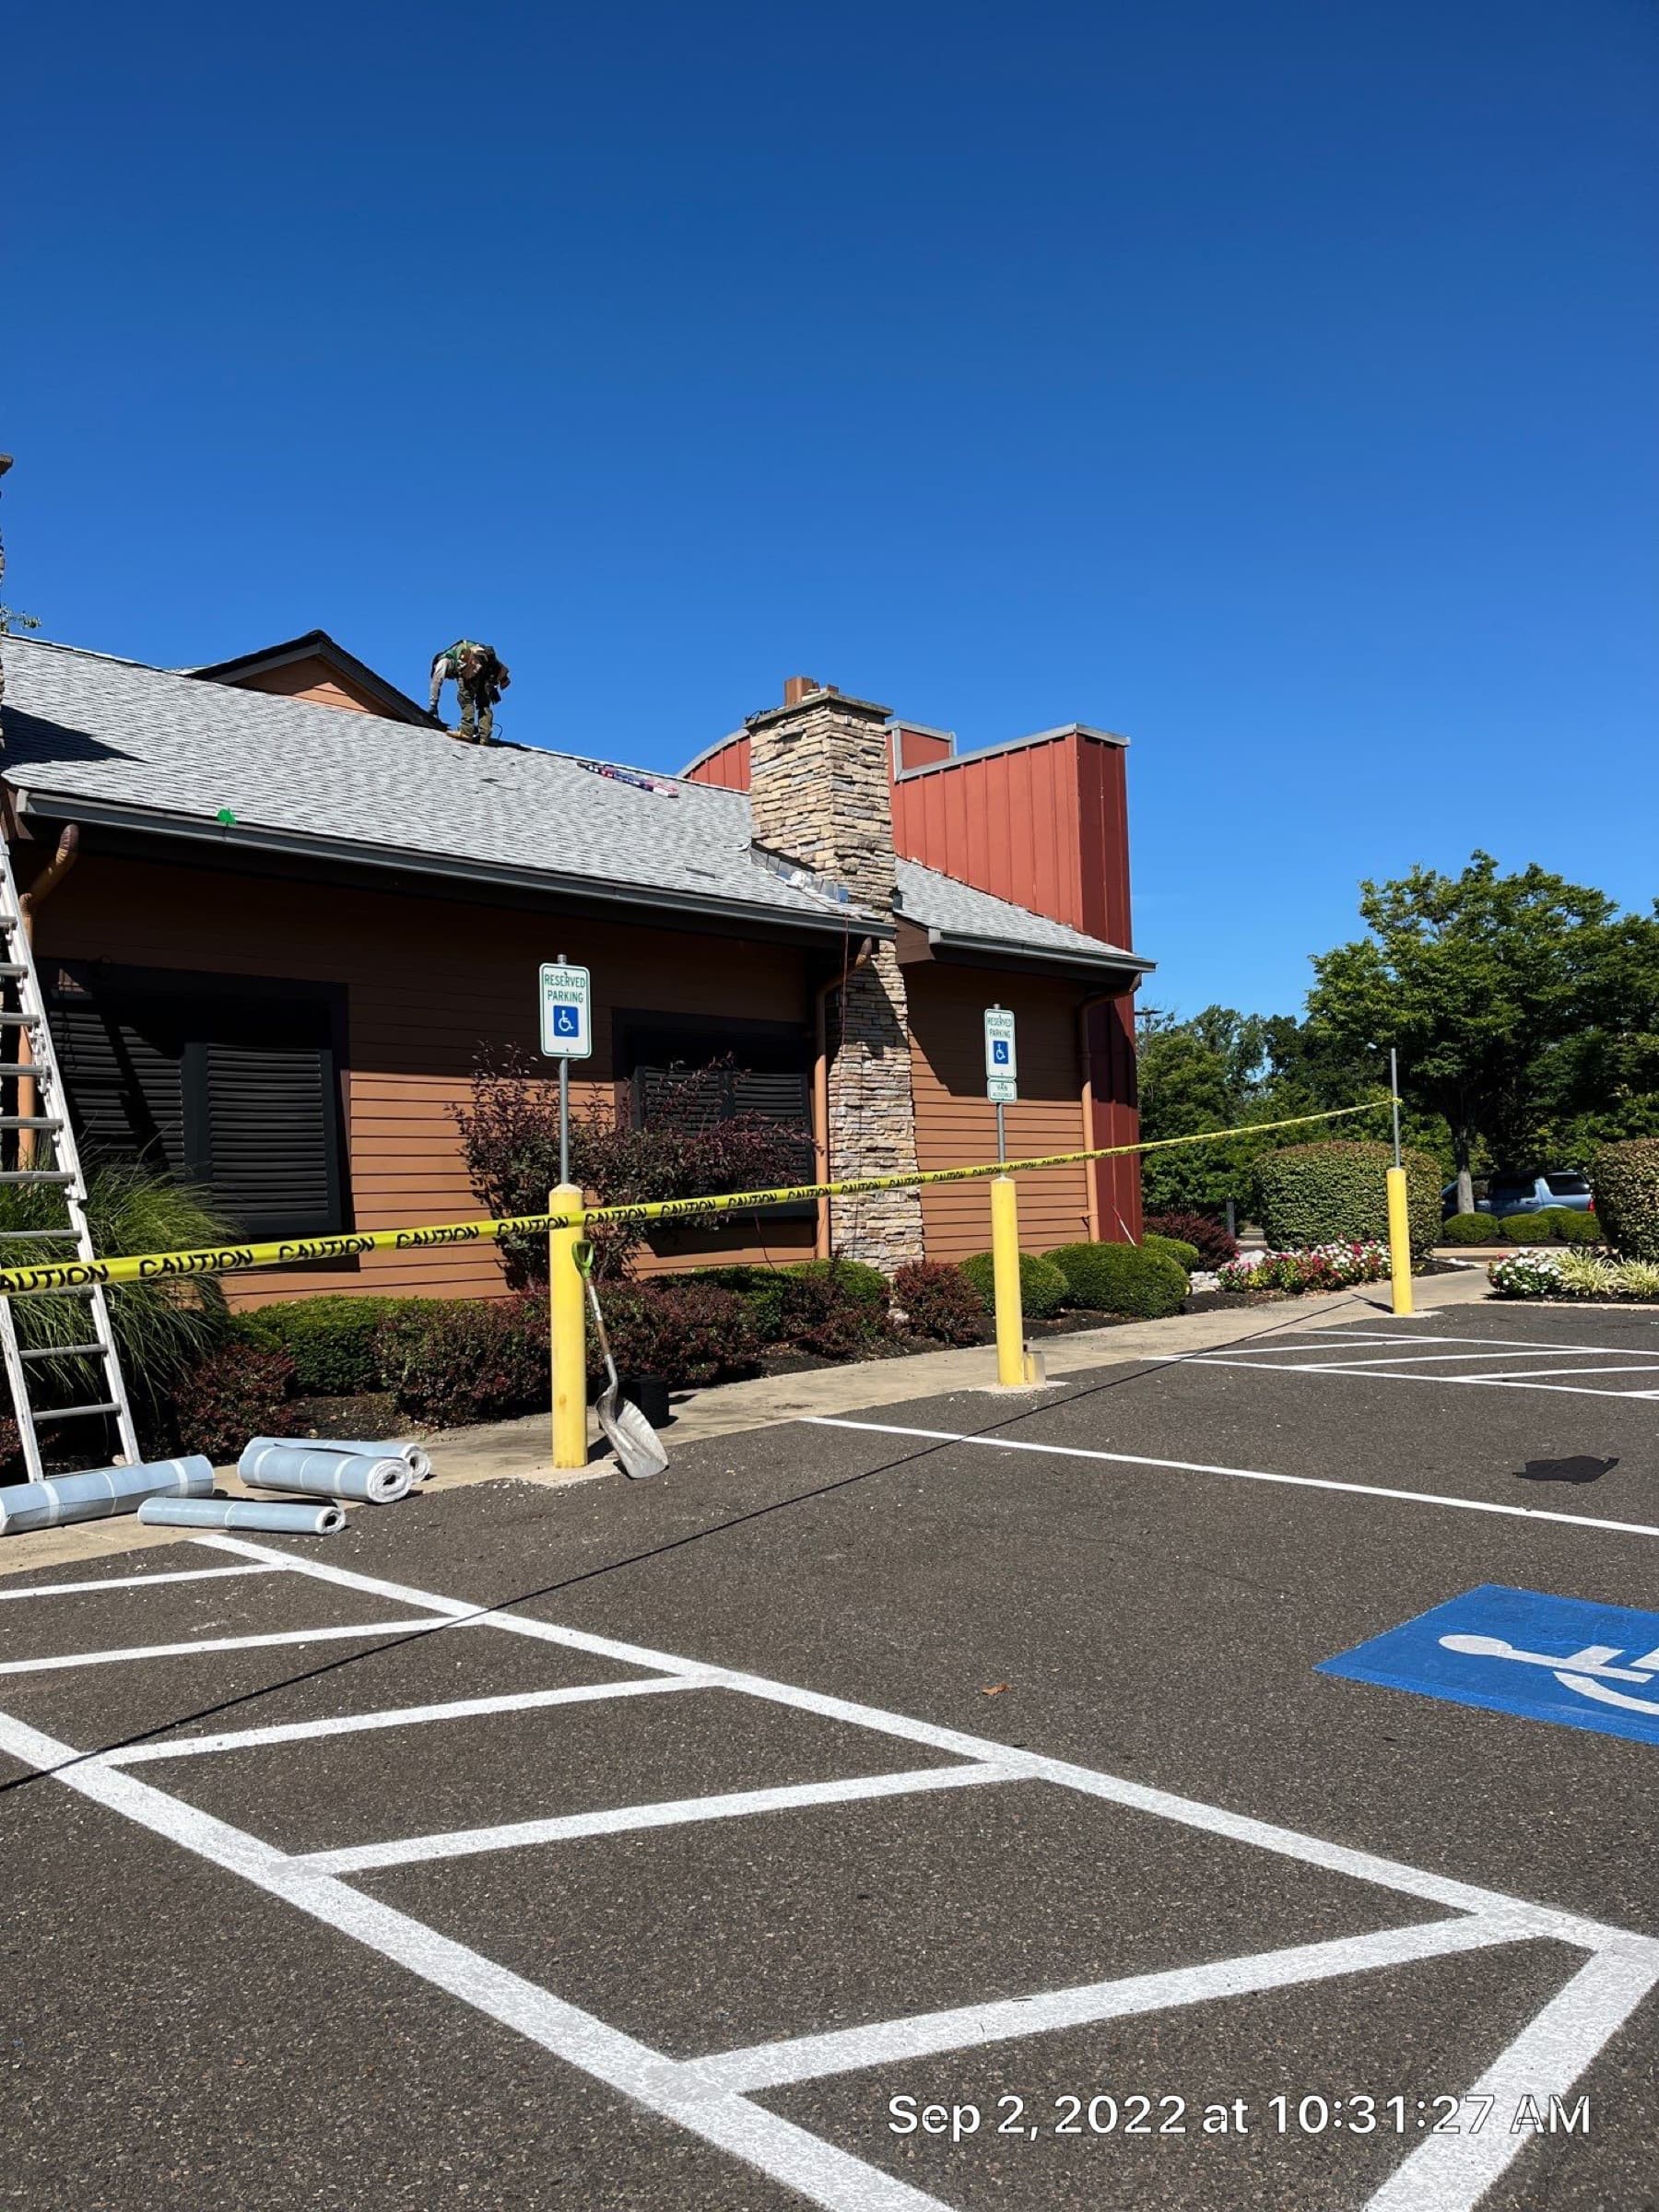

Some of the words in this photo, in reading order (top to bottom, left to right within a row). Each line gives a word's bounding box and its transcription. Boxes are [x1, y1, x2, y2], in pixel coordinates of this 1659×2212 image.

[544, 973, 586, 988] RESERVED
[547, 990, 583, 1003] PARKING
[0, 1264, 109, 1292] AUTION
[139, 1249, 253, 1278] CAUTION
[278, 1236, 375, 1262] CAUTION
[394, 1225, 480, 1249] CAUTION
[497, 1216, 569, 1236] CAUTION
[584, 1207, 647, 1226] CAUTION
[660, 1199, 715, 1217] CAUTION
[727, 1193, 778, 1207] CAUTION
[787, 1186, 831, 1202] CAUTION
[840, 1180, 881, 1195] CAUTION
[888, 1174, 925, 1188] CAUTION
[932, 1171, 966, 1182] CAUTION
[972, 1166, 1004, 1177] CAUTION
[1008, 1161, 1037, 1171] CAUTION
